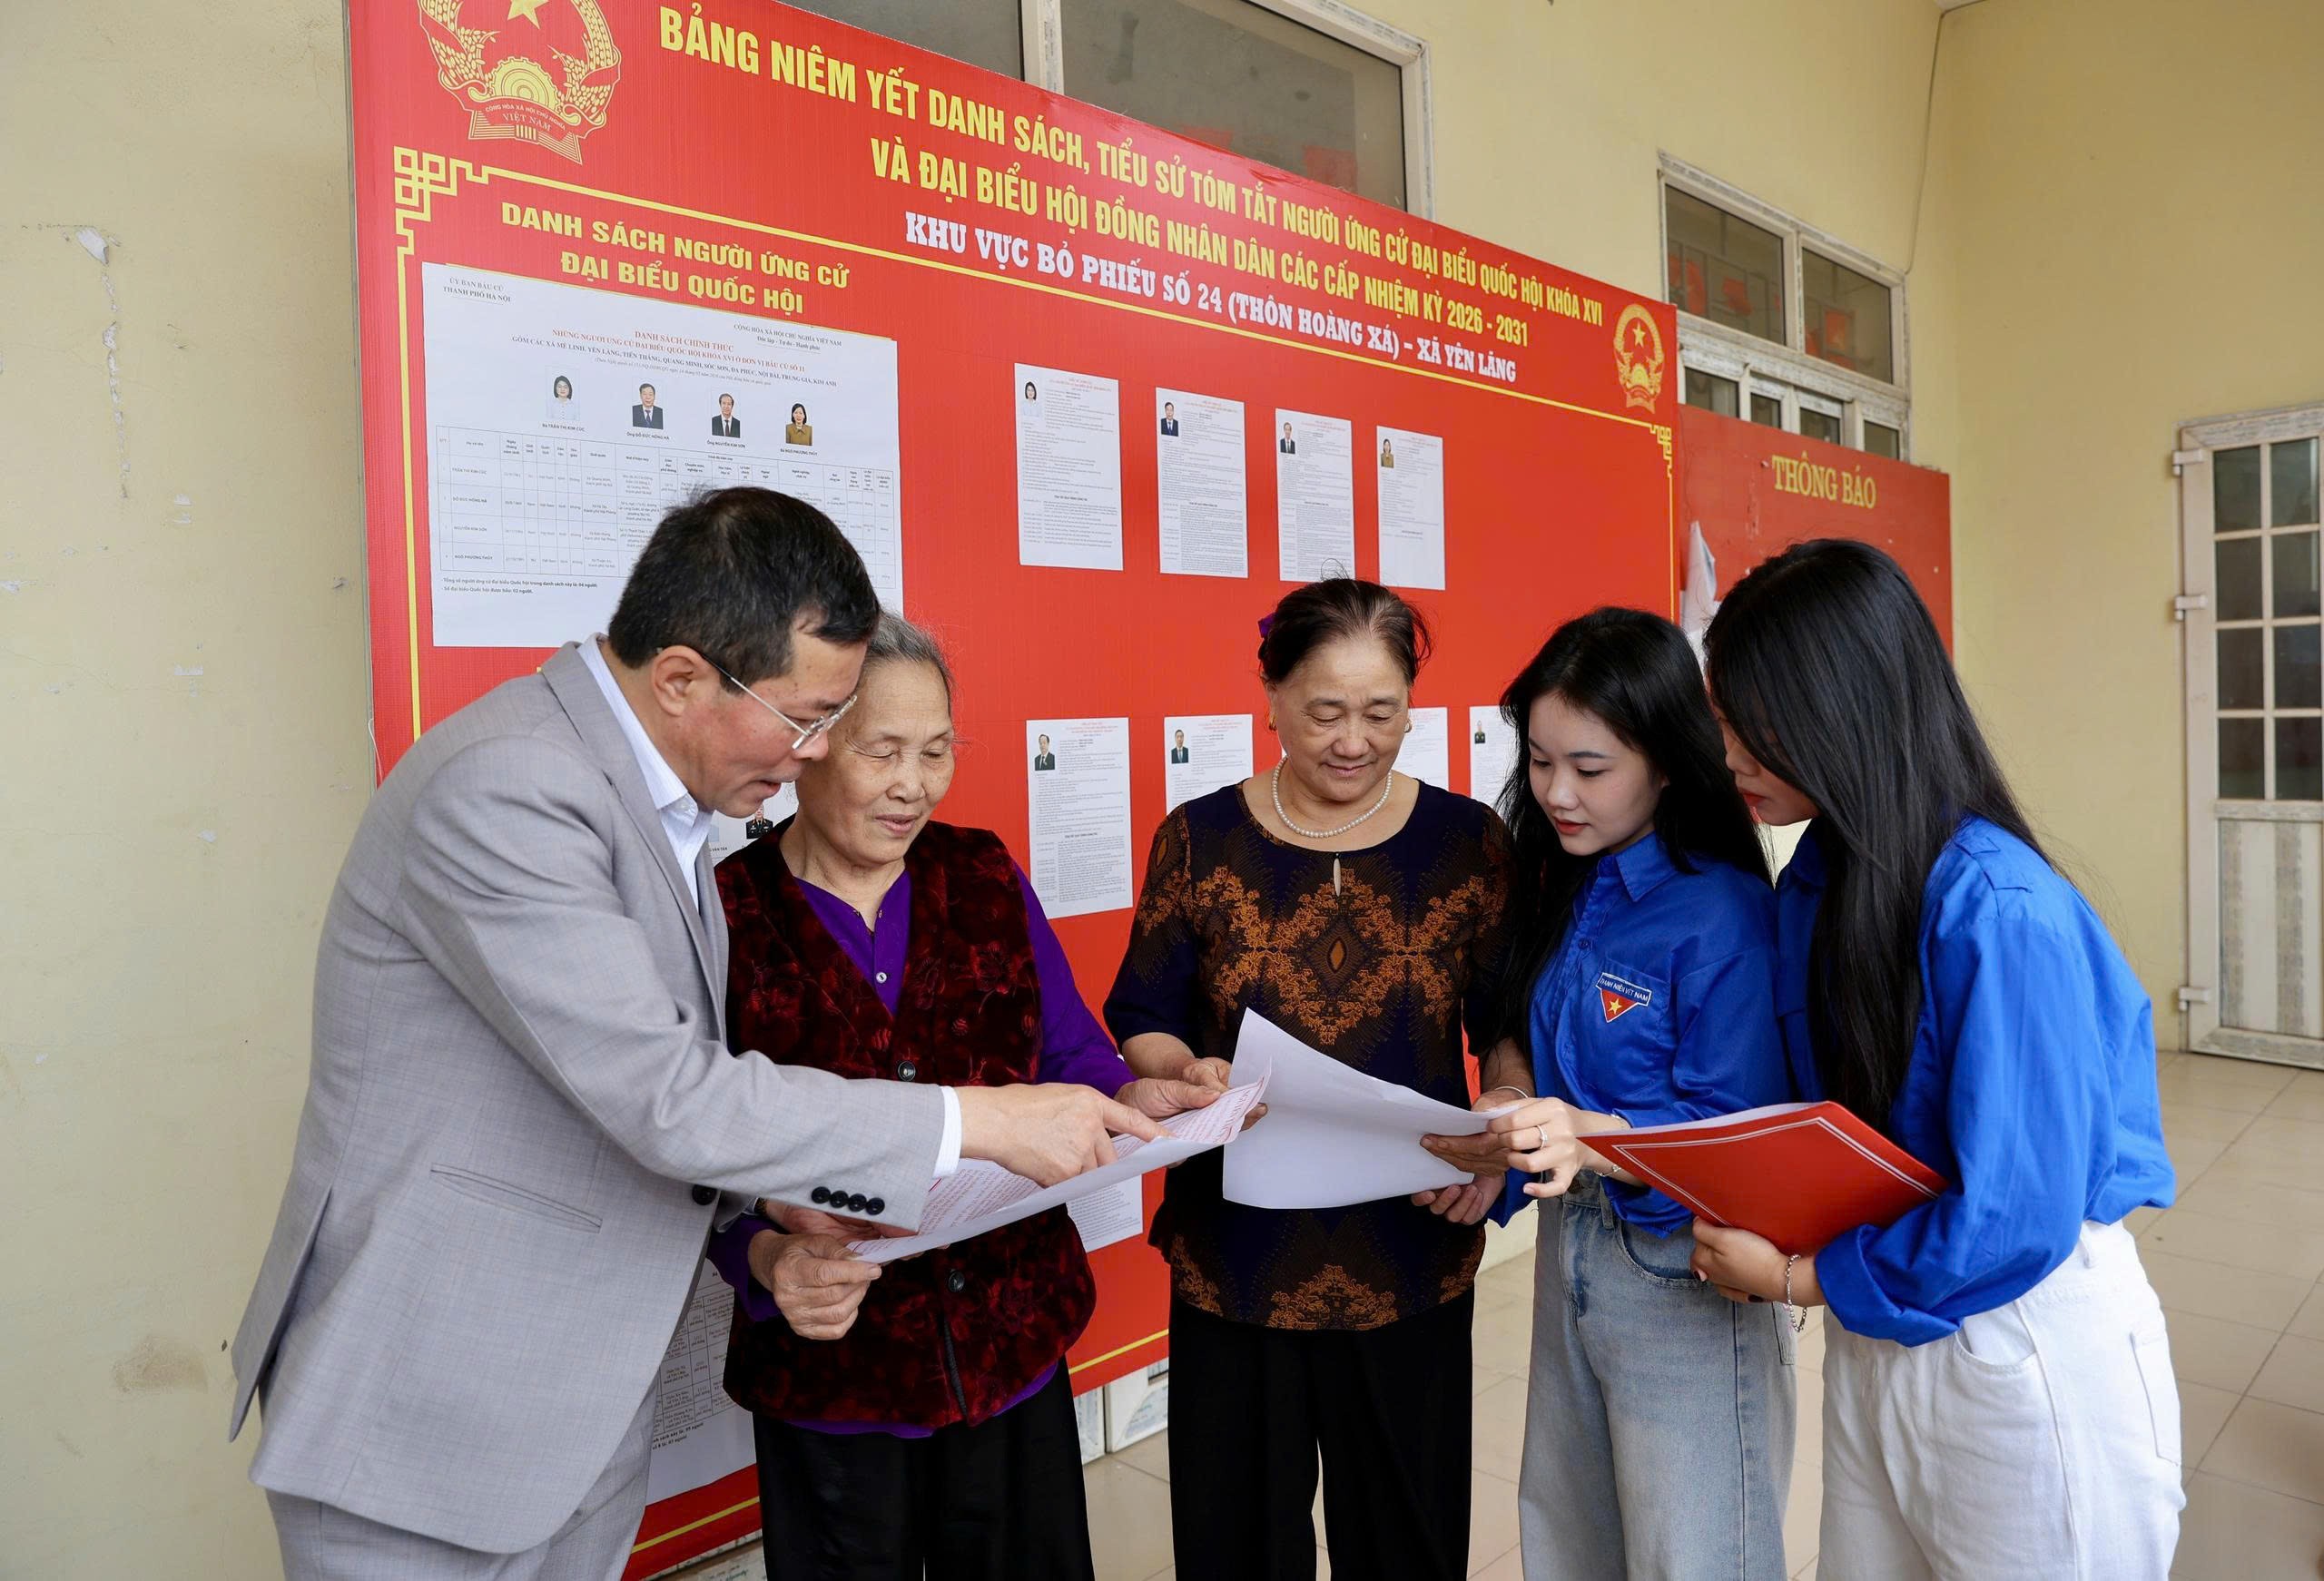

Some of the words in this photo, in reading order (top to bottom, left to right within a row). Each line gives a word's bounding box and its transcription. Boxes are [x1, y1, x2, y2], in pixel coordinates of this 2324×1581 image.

[502, 112, 527, 123] VIỆT
[529, 116, 552, 132] NAM
[660, 1, 759, 75] BẢNG
[771, 42, 855, 103] NIÊM
[866, 66, 920, 120] YẾT
[929, 89, 1004, 145] DANH
[1014, 114, 1089, 174] SÁCH,
[1097, 137, 1147, 188] TIỂU
[1155, 154, 1186, 199] SỬ
[1191, 170, 1236, 214] TÓM
[1242, 182, 1276, 226] TẮT
[1283, 201, 1339, 246] NGƯỜI
[1344, 215, 1381, 258] ỨNG
[1385, 228, 1408, 266] CỬ
[1412, 241, 1438, 280] ĐẠI
[1443, 247, 1476, 287] BIỂU
[1480, 261, 1518, 299] QUỐC
[1521, 276, 1543, 312] HỘI
[1546, 287, 1581, 319] KHÓA
[1582, 298, 1602, 327] XVI
[501, 201, 583, 238] DANH
[592, 219, 665, 254] SÁCH
[675, 237, 753, 272] NGƯỜI
[759, 246, 810, 282] ỨNG
[817, 260, 850, 289] CỬ
[870, 137, 911, 184] VÀ
[919, 151, 967, 202] ĐẠI
[977, 162, 1038, 216] BIỂU
[1046, 185, 1088, 235] HỘI
[1096, 199, 1160, 250] ĐỒNG
[1167, 220, 1227, 267] NHÂN
[1234, 234, 1275, 280] DÂN
[1281, 251, 1319, 290] CÁC
[1324, 259, 1360, 300] CẤP
[1365, 276, 1418, 319] NHIỆM
[1423, 290, 1443, 324] KỲ
[1447, 300, 1483, 338] 2026
[1496, 314, 1527, 347] 2031
[561, 250, 608, 279] ĐẠI
[619, 253, 678, 292] BIỂU
[688, 268, 757, 305] QUỐC
[764, 285, 803, 314] HỘI
[905, 211, 966, 254] KHU
[975, 228, 1029, 270] VỰC
[1037, 241, 1075, 279] BỎ
[1082, 258, 1156, 299] PHIẾU
[1163, 270, 1190, 308] SỐ
[1197, 283, 1222, 313] 24
[1228, 292, 1293, 330] (THÔN
[1299, 304, 1363, 346] HOÀNG
[1367, 323, 1399, 360] XÁ)
[1444, 341, 1474, 373] YÊN
[635, 331, 659, 342] DANH
[1772, 451, 1837, 500] THÔNG
[1842, 465, 1876, 508] BÁO
[1634, 991, 1648, 1001] NAM
